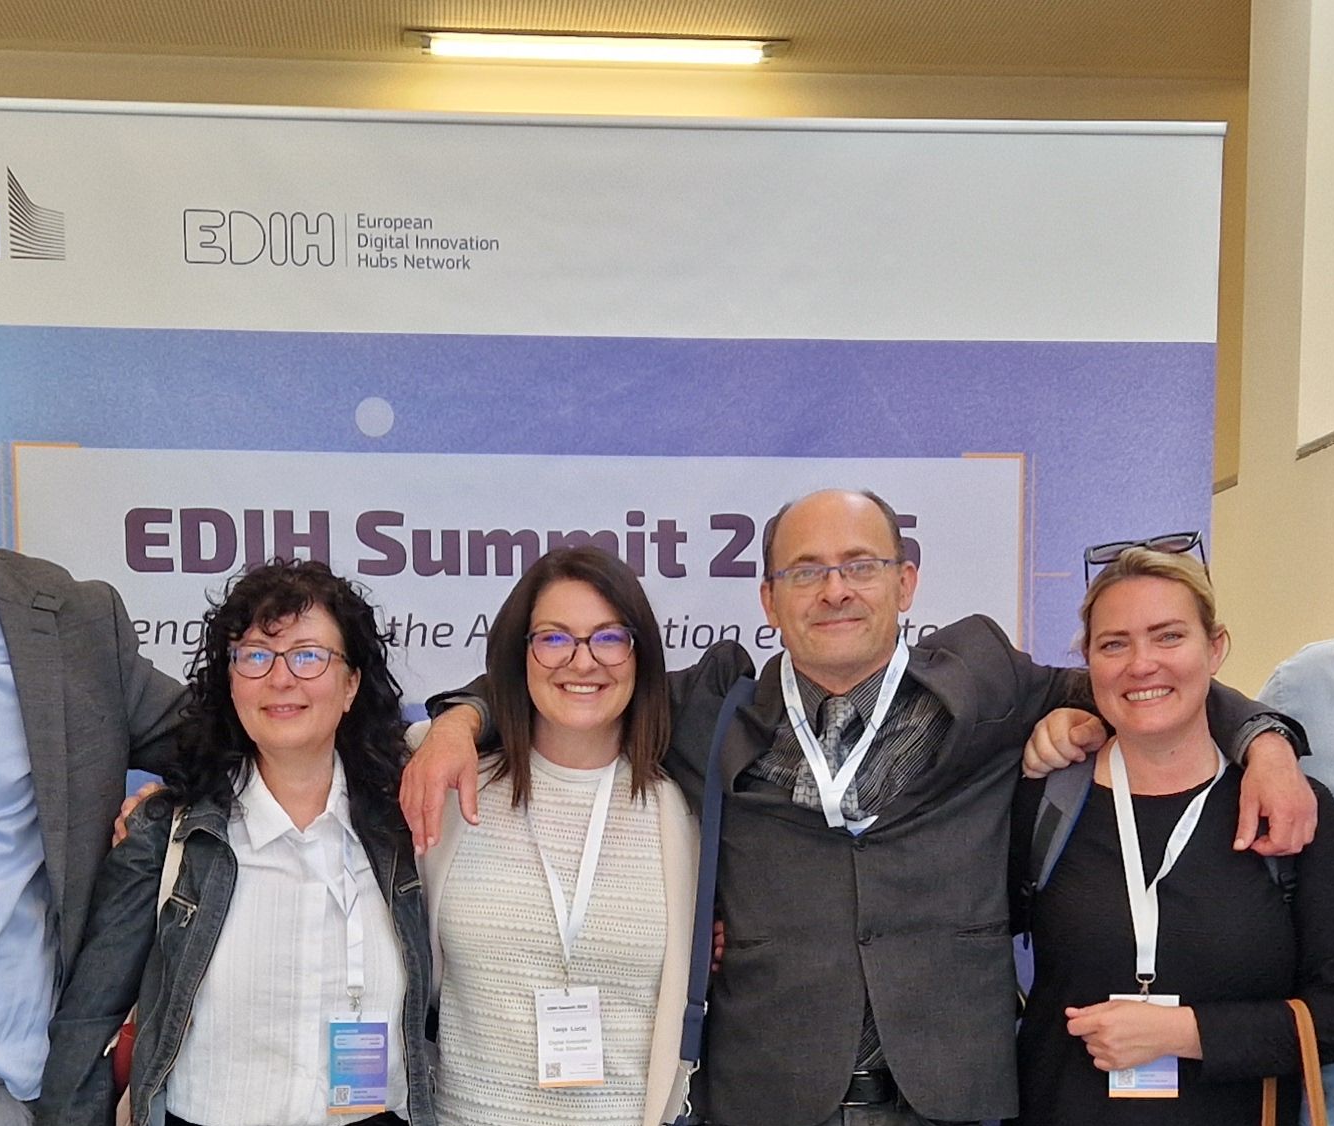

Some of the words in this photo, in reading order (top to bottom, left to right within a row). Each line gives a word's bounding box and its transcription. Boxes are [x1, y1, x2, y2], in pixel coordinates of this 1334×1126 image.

[356, 213, 434, 231] European
[183, 208, 335, 267] EDIH
[356, 232, 410, 252] Digital
[415, 234, 500, 251] Innovation
[356, 252, 399, 269] Hubs
[403, 254, 472, 270] Network
[123, 507, 331, 575] EDIH
[709, 512, 921, 579] 25
[386, 612, 454, 648] the
